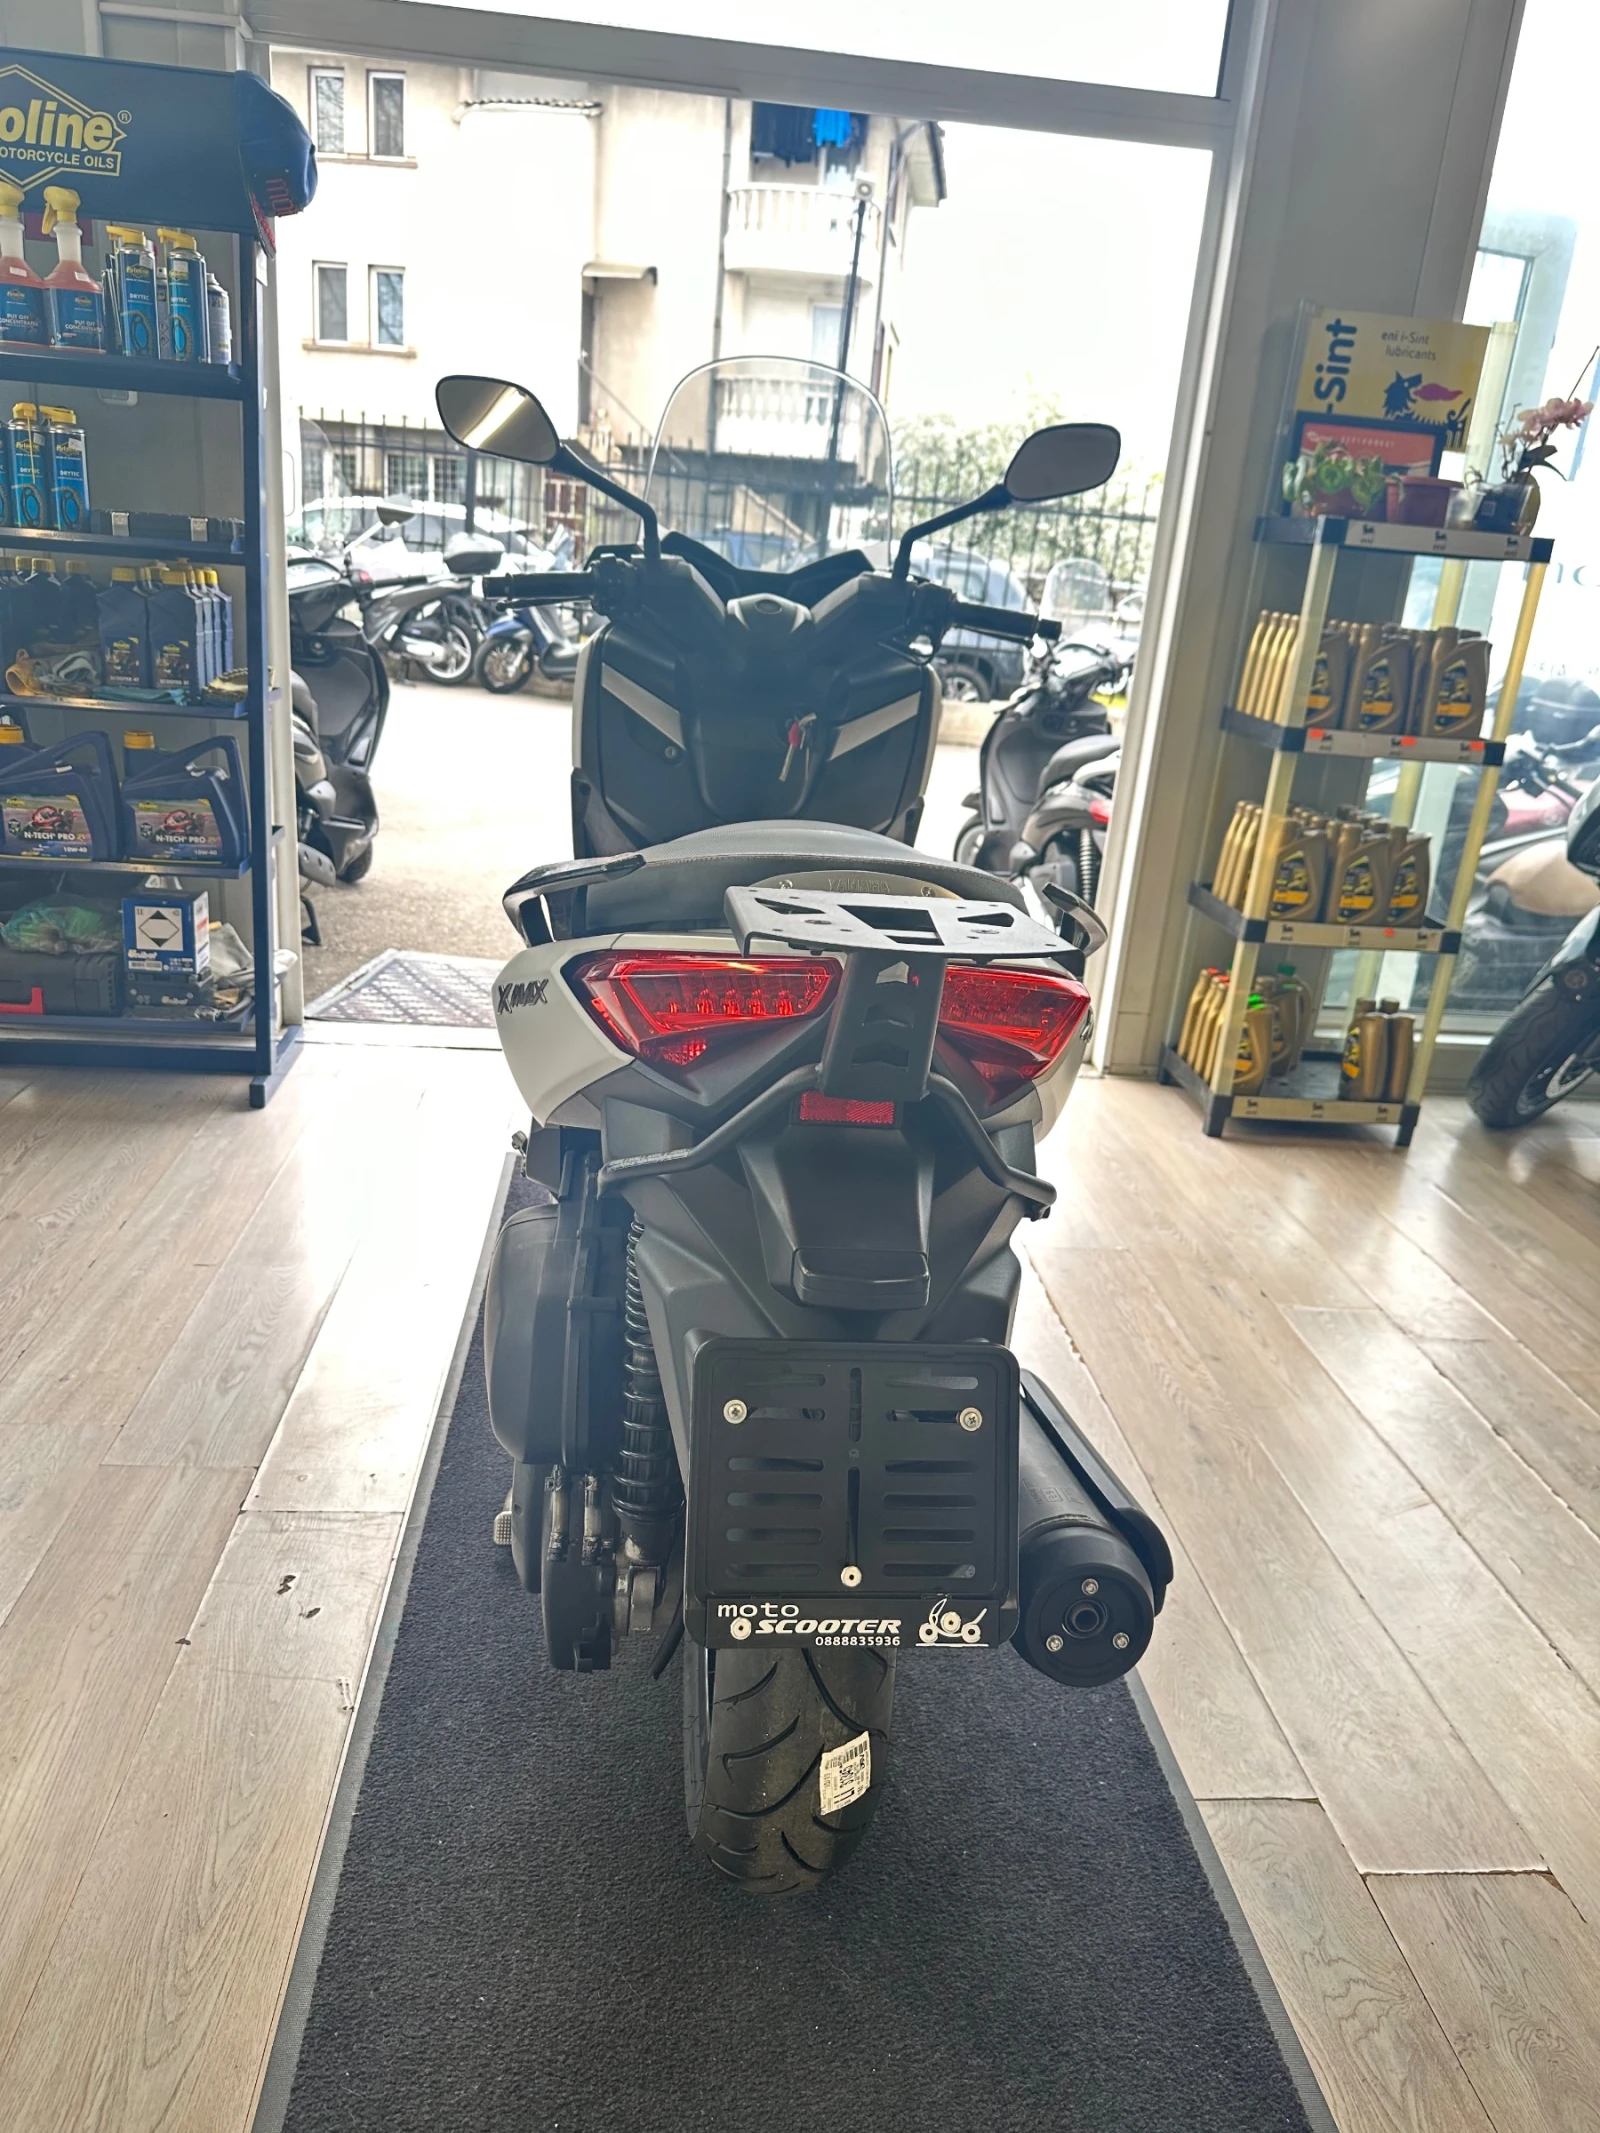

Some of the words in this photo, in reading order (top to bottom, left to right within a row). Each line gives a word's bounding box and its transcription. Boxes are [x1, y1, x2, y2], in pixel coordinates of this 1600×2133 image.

[84, 156, 114, 169] OILS
[1381, 331, 1398, 342] eni
[1400, 332, 1430, 345] i-Sint
[1385, 347, 1437, 361] lubricants
[189, 836, 206, 844] PRO
[498, 979, 549, 1015] XMAX
[718, 1602, 799, 1617] moto
[755, 1619, 902, 1634] SCOOTER
[815, 1636, 900, 1647] 0888835936
